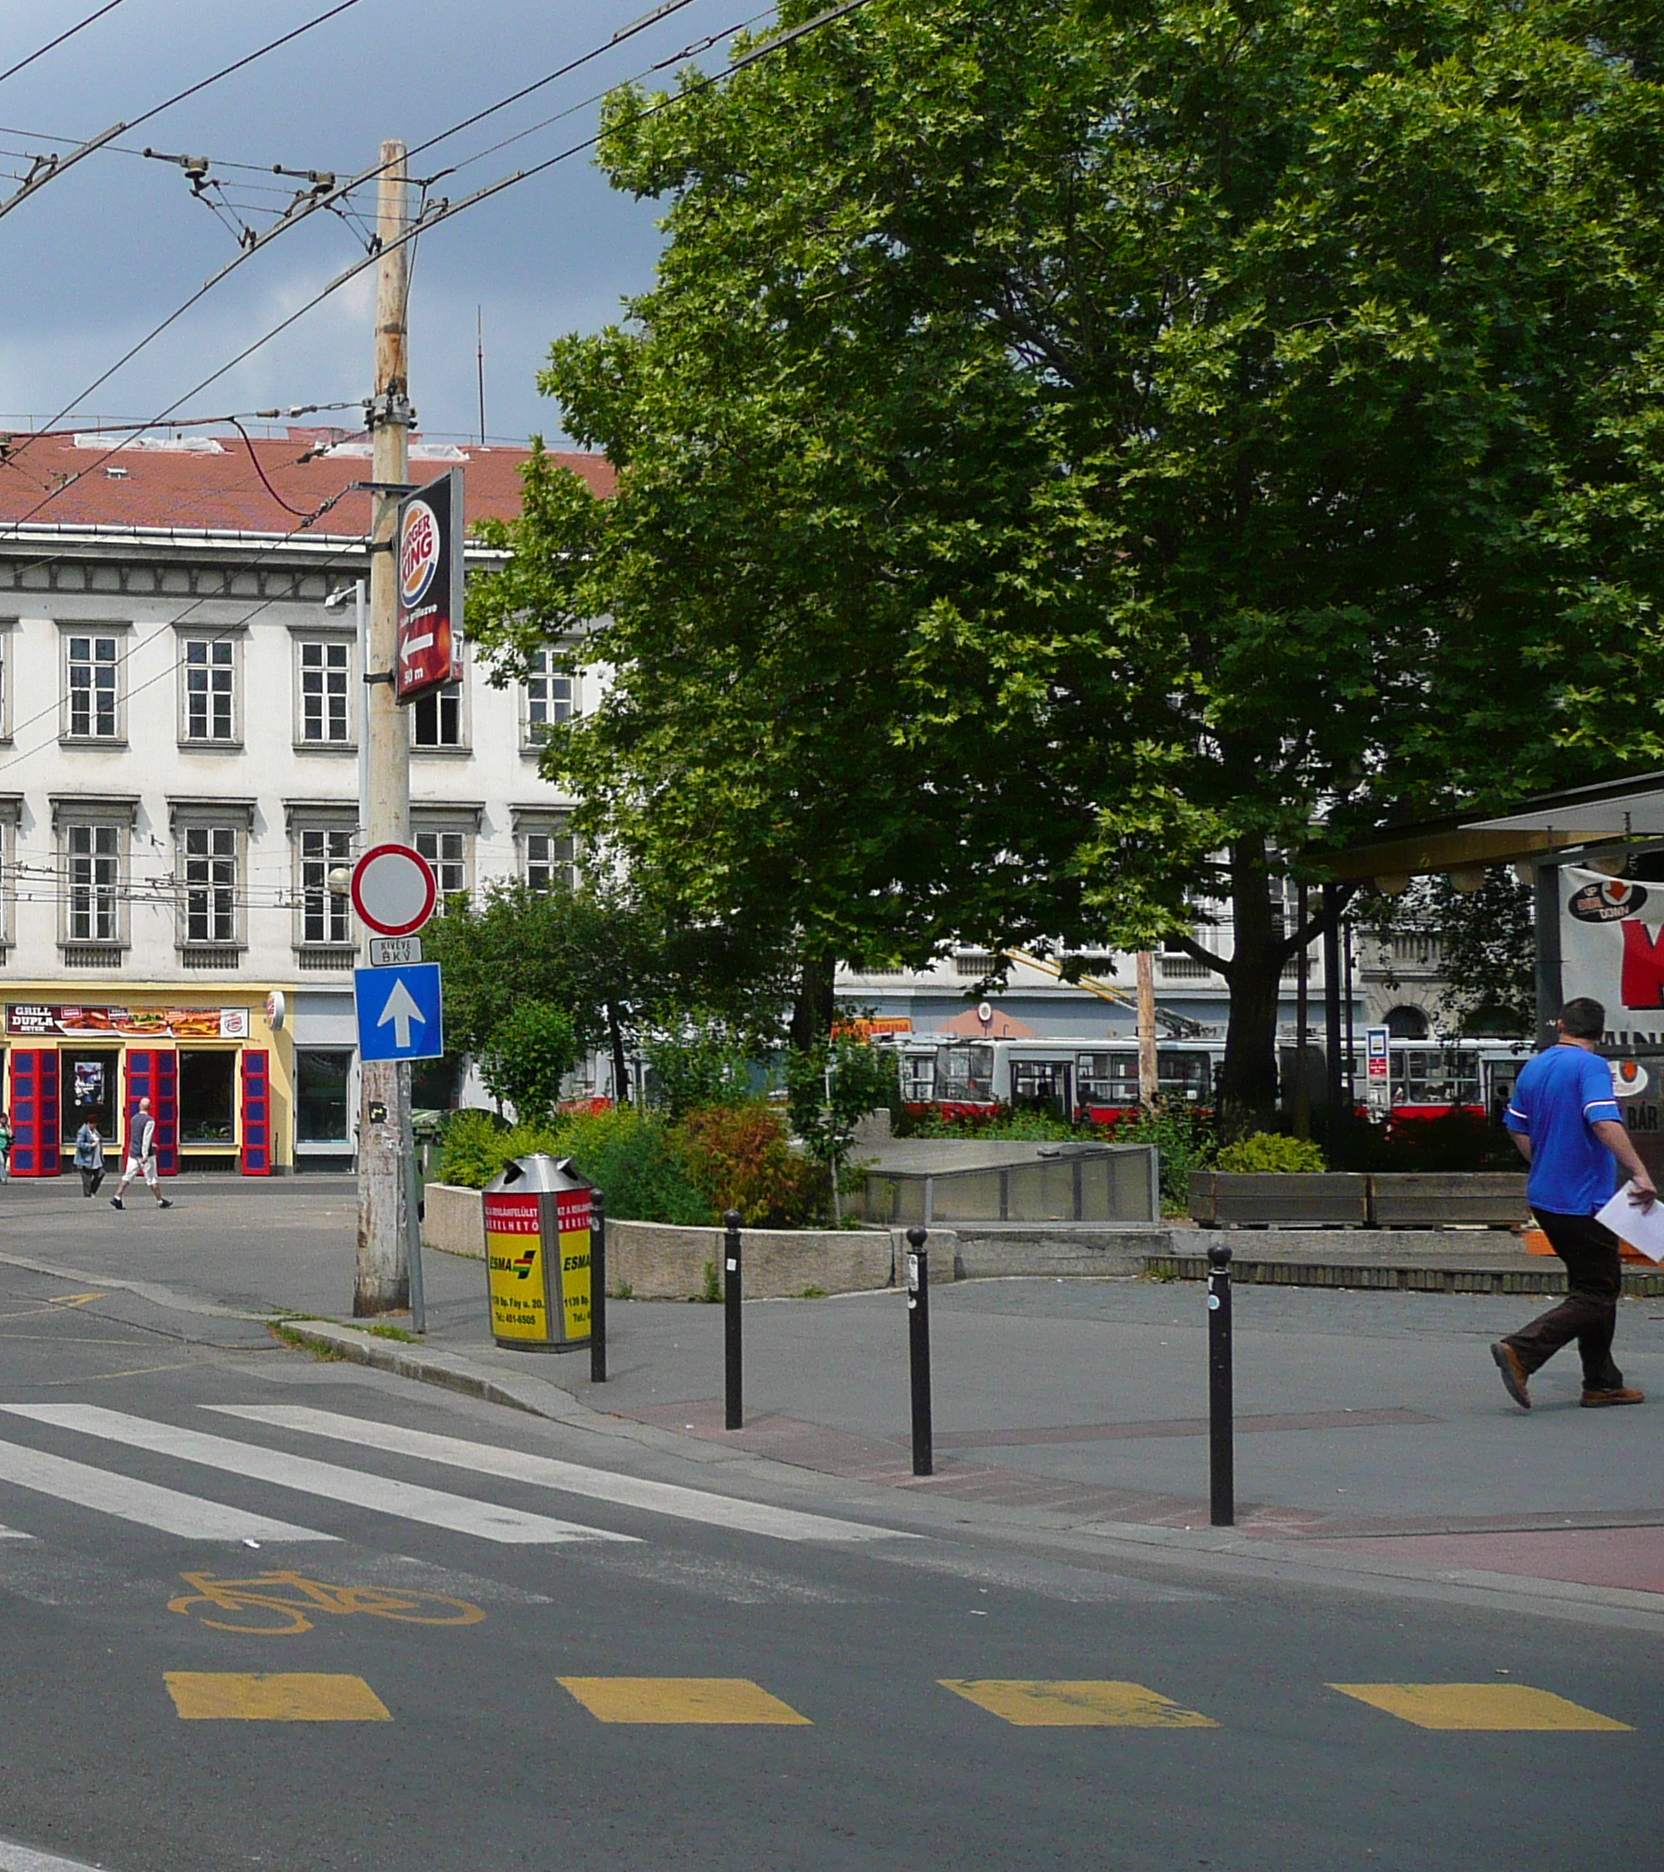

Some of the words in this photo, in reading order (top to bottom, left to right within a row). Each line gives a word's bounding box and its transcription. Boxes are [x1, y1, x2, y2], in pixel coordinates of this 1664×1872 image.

[414, 667, 424, 681] m
[382, 950, 411, 963] BKV
[15, 1006, 52, 1017] GRILL
[11, 1015, 54, 1027] DUPLA
[1627, 1101, 1658, 1131] BÁR
[490, 1256, 512, 1272] ESMA
